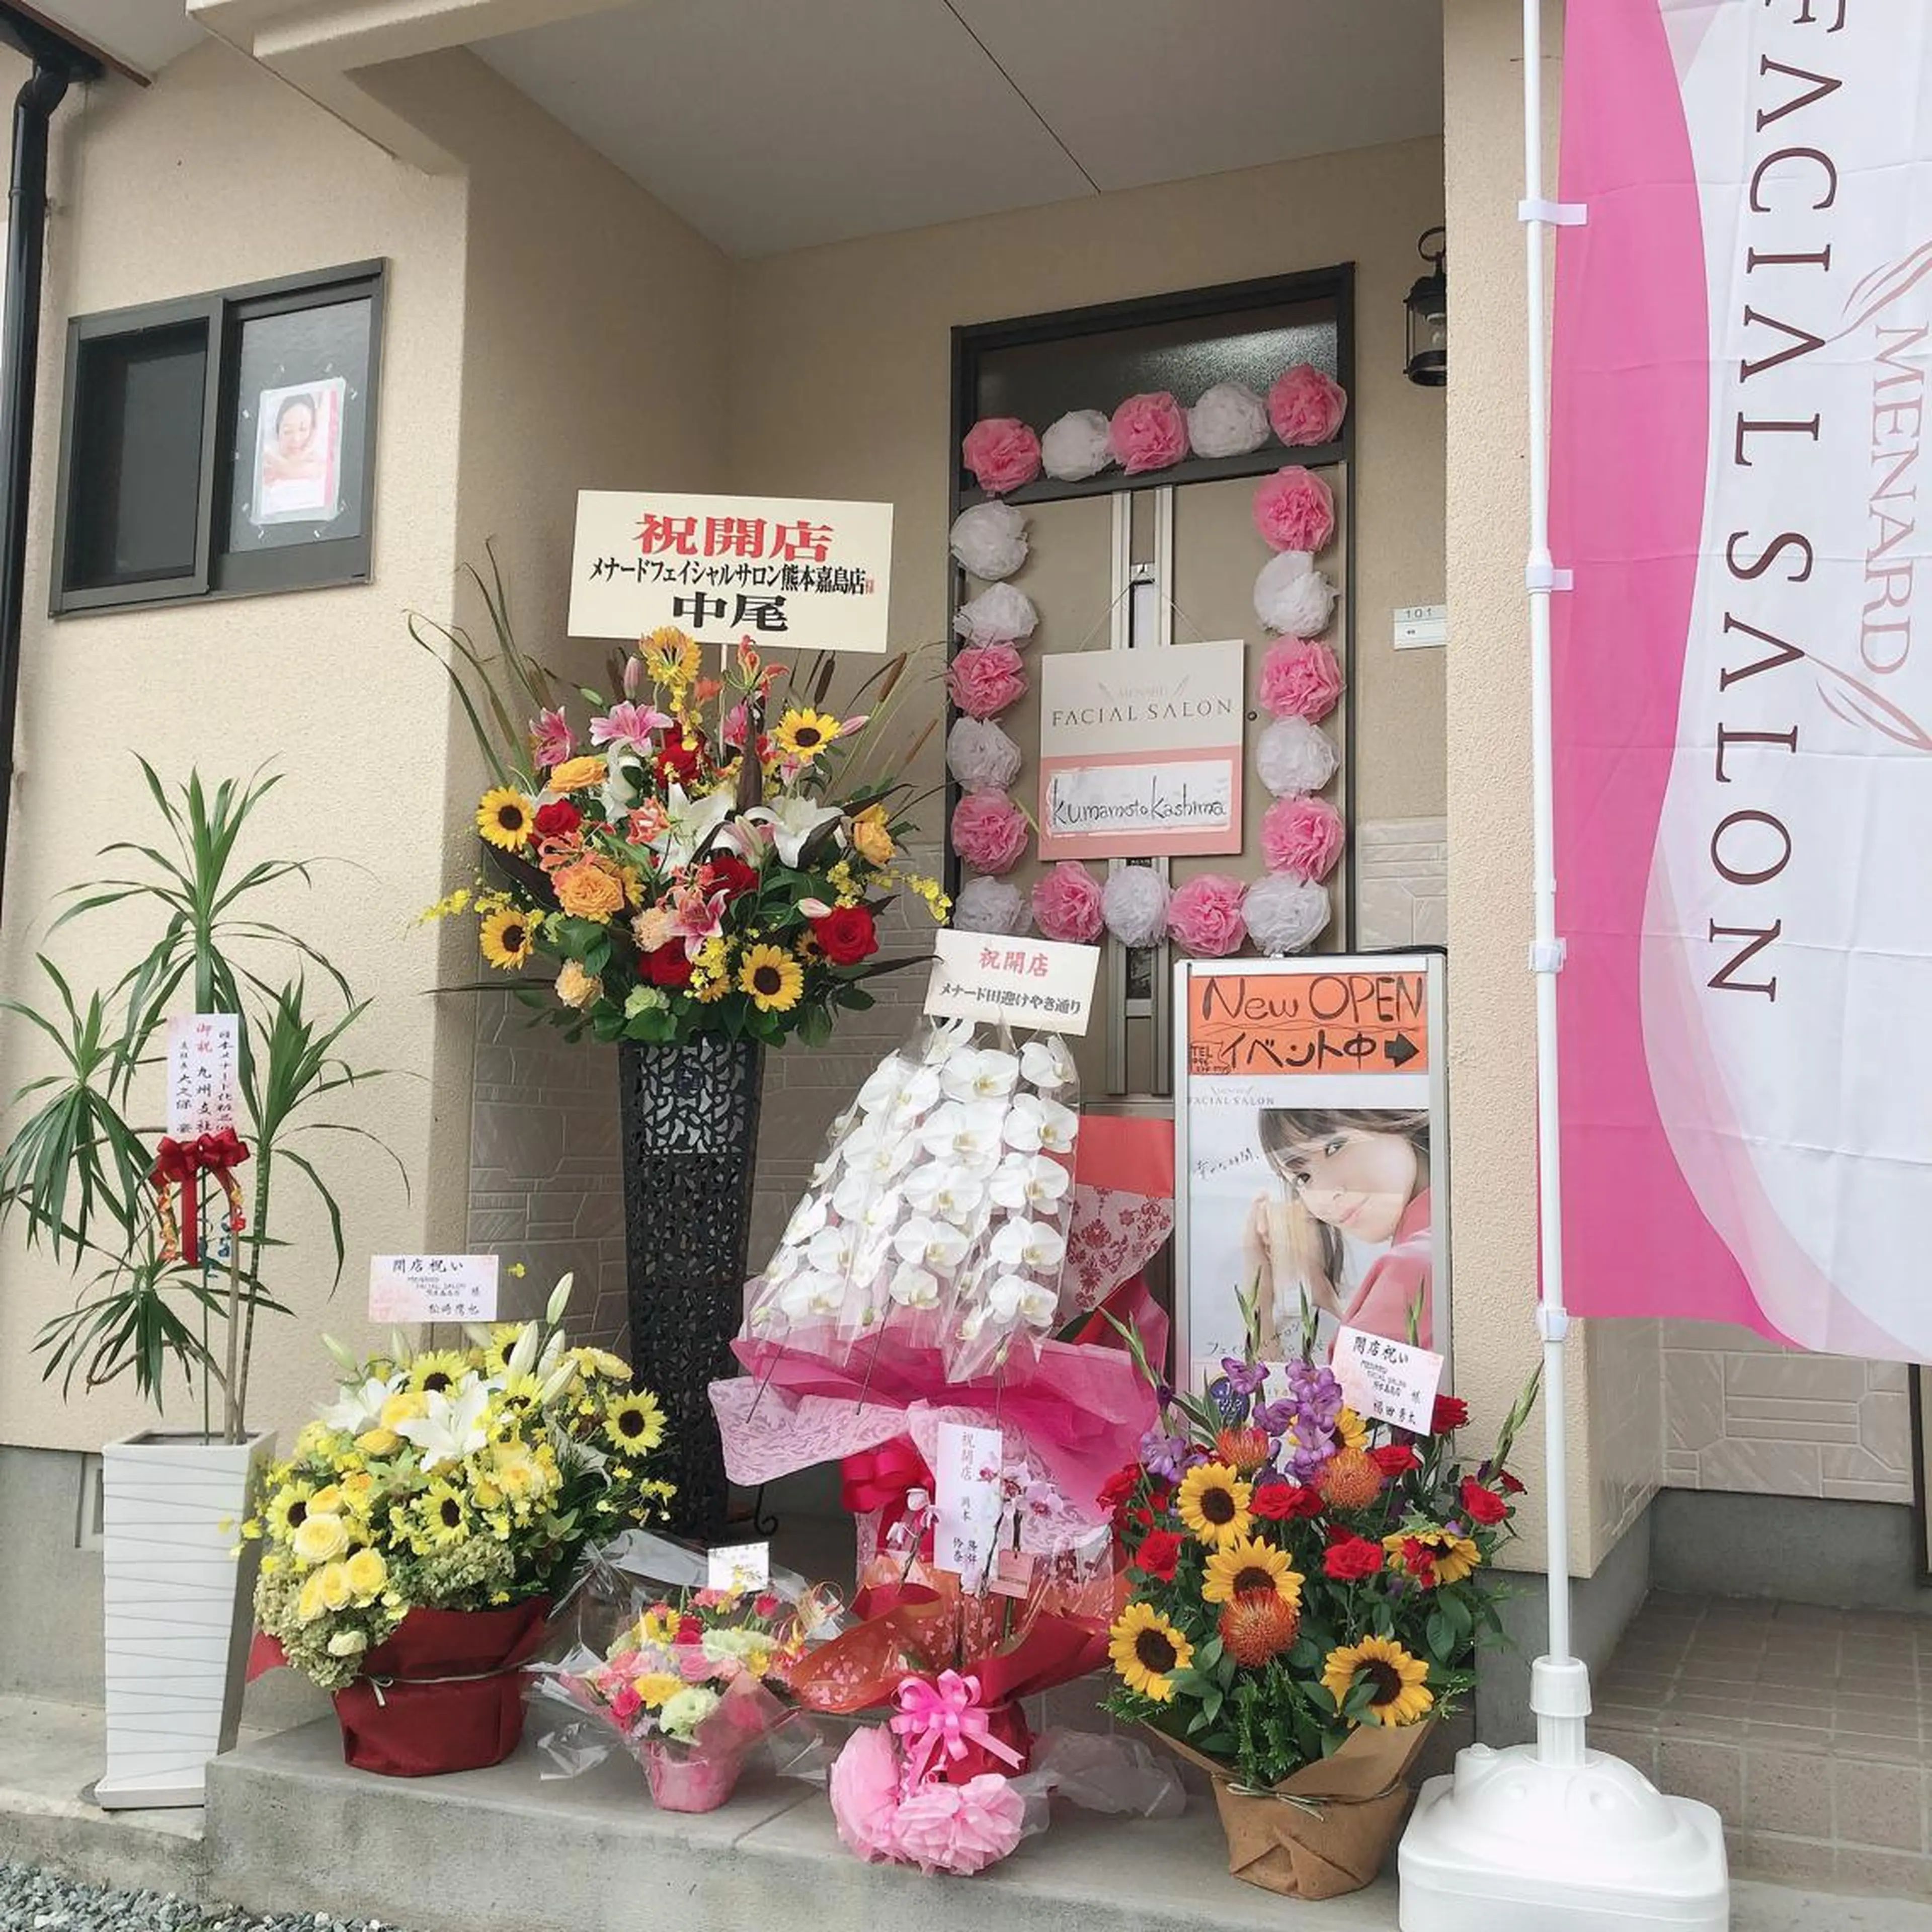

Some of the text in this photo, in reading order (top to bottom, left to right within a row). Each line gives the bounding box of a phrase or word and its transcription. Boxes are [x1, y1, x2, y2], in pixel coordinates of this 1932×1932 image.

[1859, 324, 1929, 675] MENARD
[635, 513, 834, 562] 祝開店
[673, 591, 788, 632] 中尾
[1406, 607, 1431, 619] 101
[1052, 698, 1232, 727] FACIAL SALON
[1707, 530, 1813, 1002] SALON
[979, 947, 1049, 977] 祝開店
[1201, 975, 1423, 1023] New OPEN
[1221, 1029, 1377, 1070] イベント中
[392, 1258, 463, 1273] 開店祝い
[1353, 1336, 1409, 1364] 開店祝い
